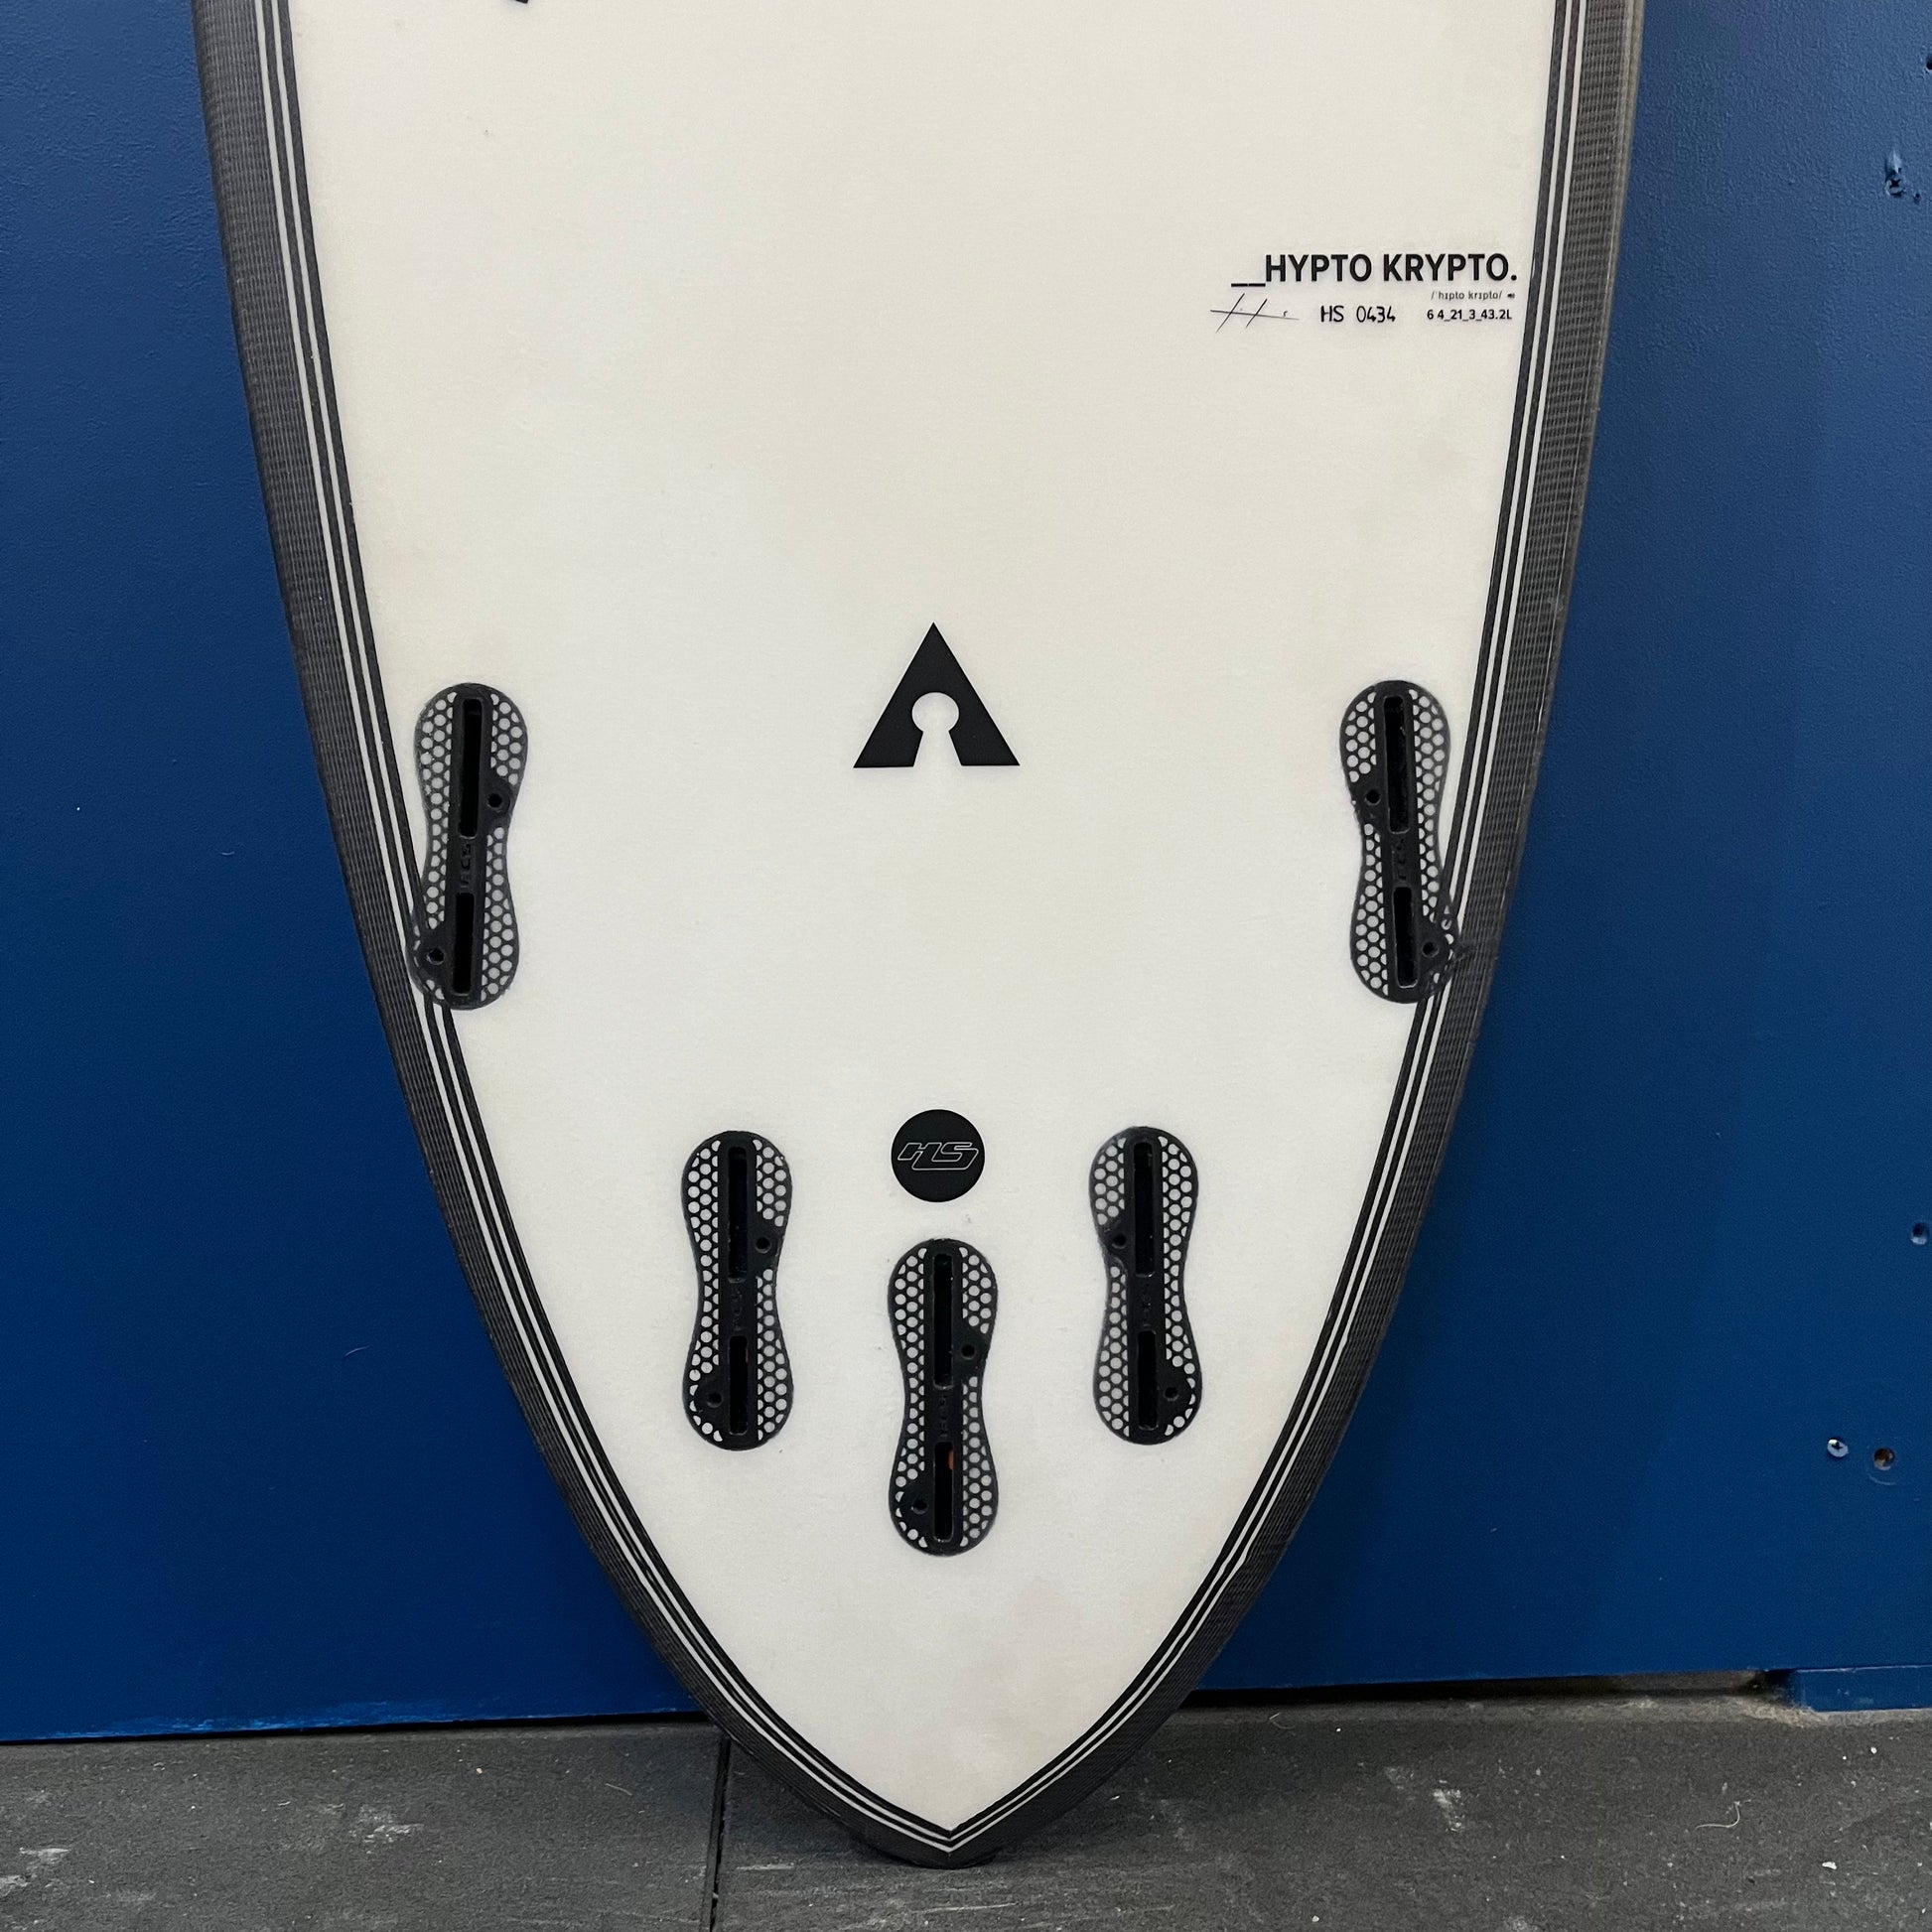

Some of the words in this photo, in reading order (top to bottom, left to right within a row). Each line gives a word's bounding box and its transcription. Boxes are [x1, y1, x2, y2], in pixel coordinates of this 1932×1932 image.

[1383, 253, 1518, 282] KRYPTO.
[1320, 305, 1344, 323] HS
[1356, 305, 1396, 323] 0434
